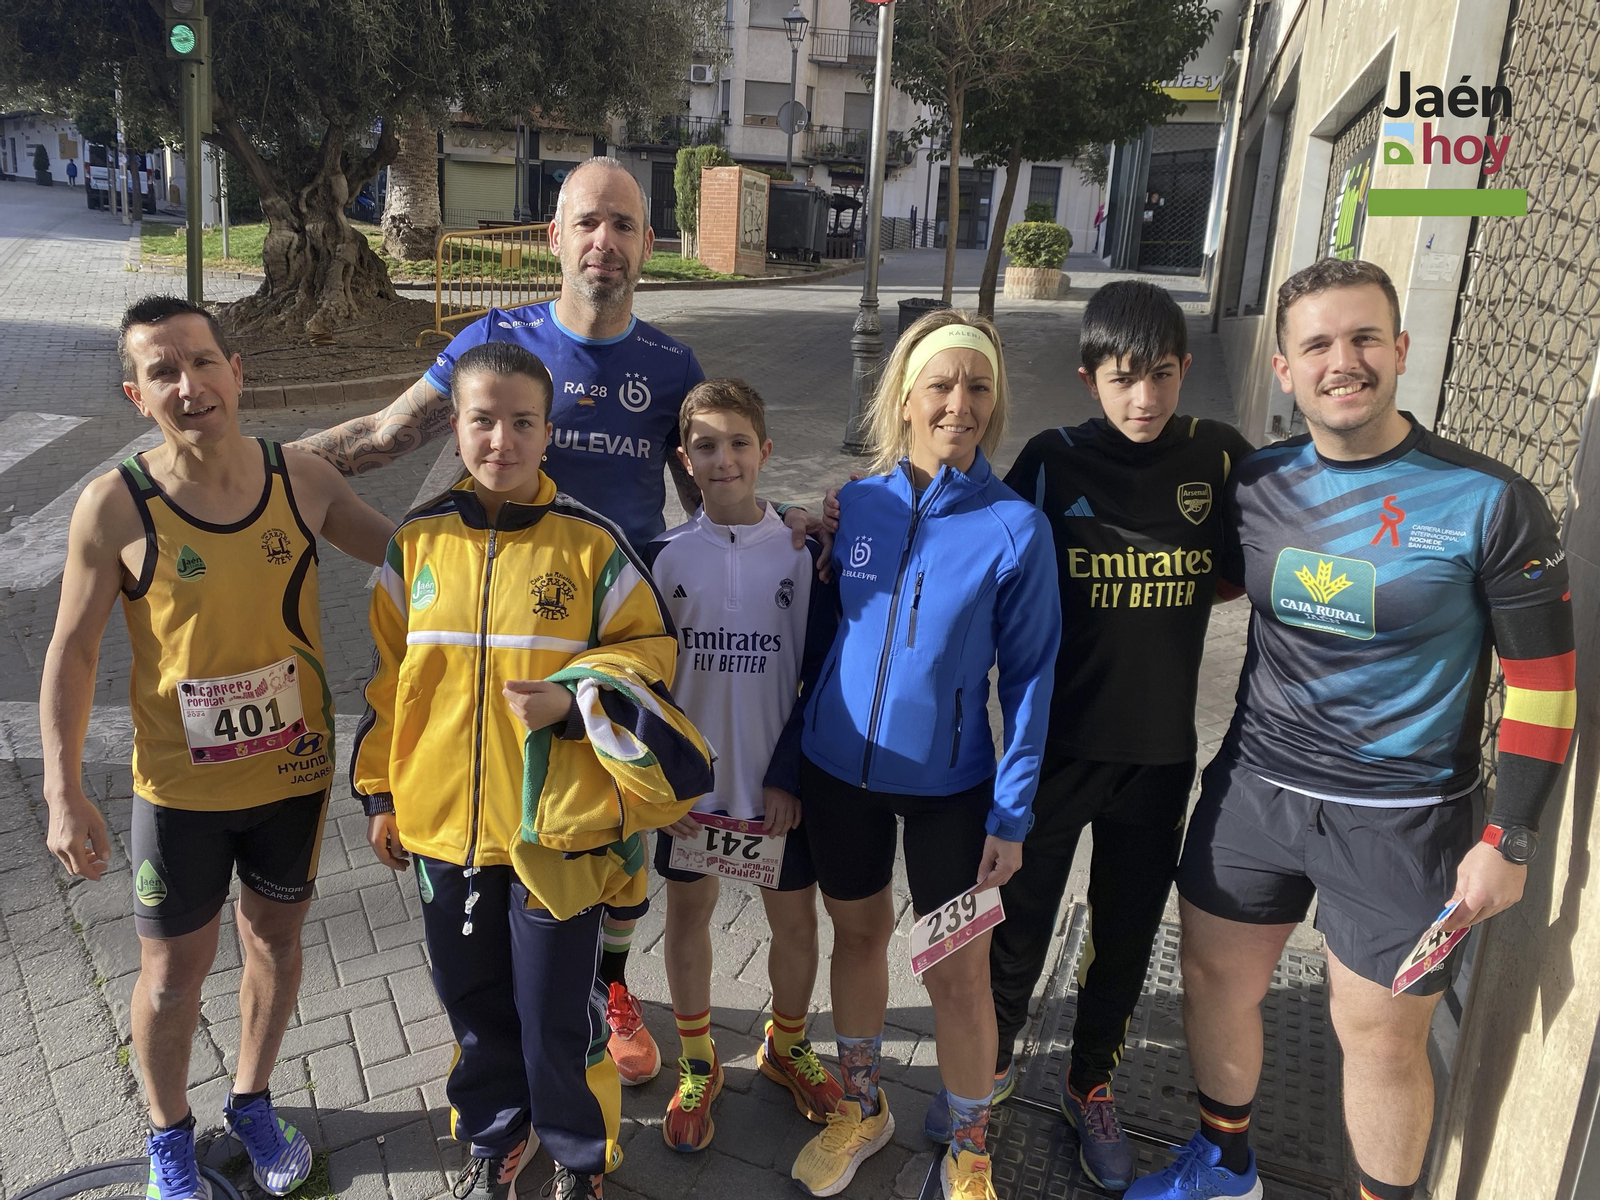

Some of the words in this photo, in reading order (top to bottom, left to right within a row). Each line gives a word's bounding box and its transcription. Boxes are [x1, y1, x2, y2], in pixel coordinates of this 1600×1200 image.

[564, 382, 585, 395] RA
[589, 384, 608, 397] 28
[1410, 531, 1459, 542] INTERNACIONAL
[1412, 525, 1441, 534] CARRERA
[1441, 529, 1466, 537] URBANA
[1409, 537, 1433, 545] NOCHE
[1422, 543, 1445, 552] ANTÓN
[178, 557, 202, 573] Jaén
[1067, 546, 1213, 578] Emirates
[413, 580, 434, 599] Jaén
[1091, 583, 1123, 608] FLY
[1129, 580, 1196, 608] BETTER
[1280, 598, 1313, 613] CAJA
[1316, 605, 1365, 624] RURAL
[680, 627, 782, 652] Emirates
[694, 653, 714, 671] FLY
[719, 654, 767, 673] BETTER
[214, 698, 286, 742] 401
[291, 766, 332, 784] JACARS
[704, 826, 763, 860] 241
[137, 876, 162, 892] Jaén
[255, 884, 296, 900] JACARSA
[263, 880, 304, 893] HYUNDAI
[927, 893, 977, 946] 239
